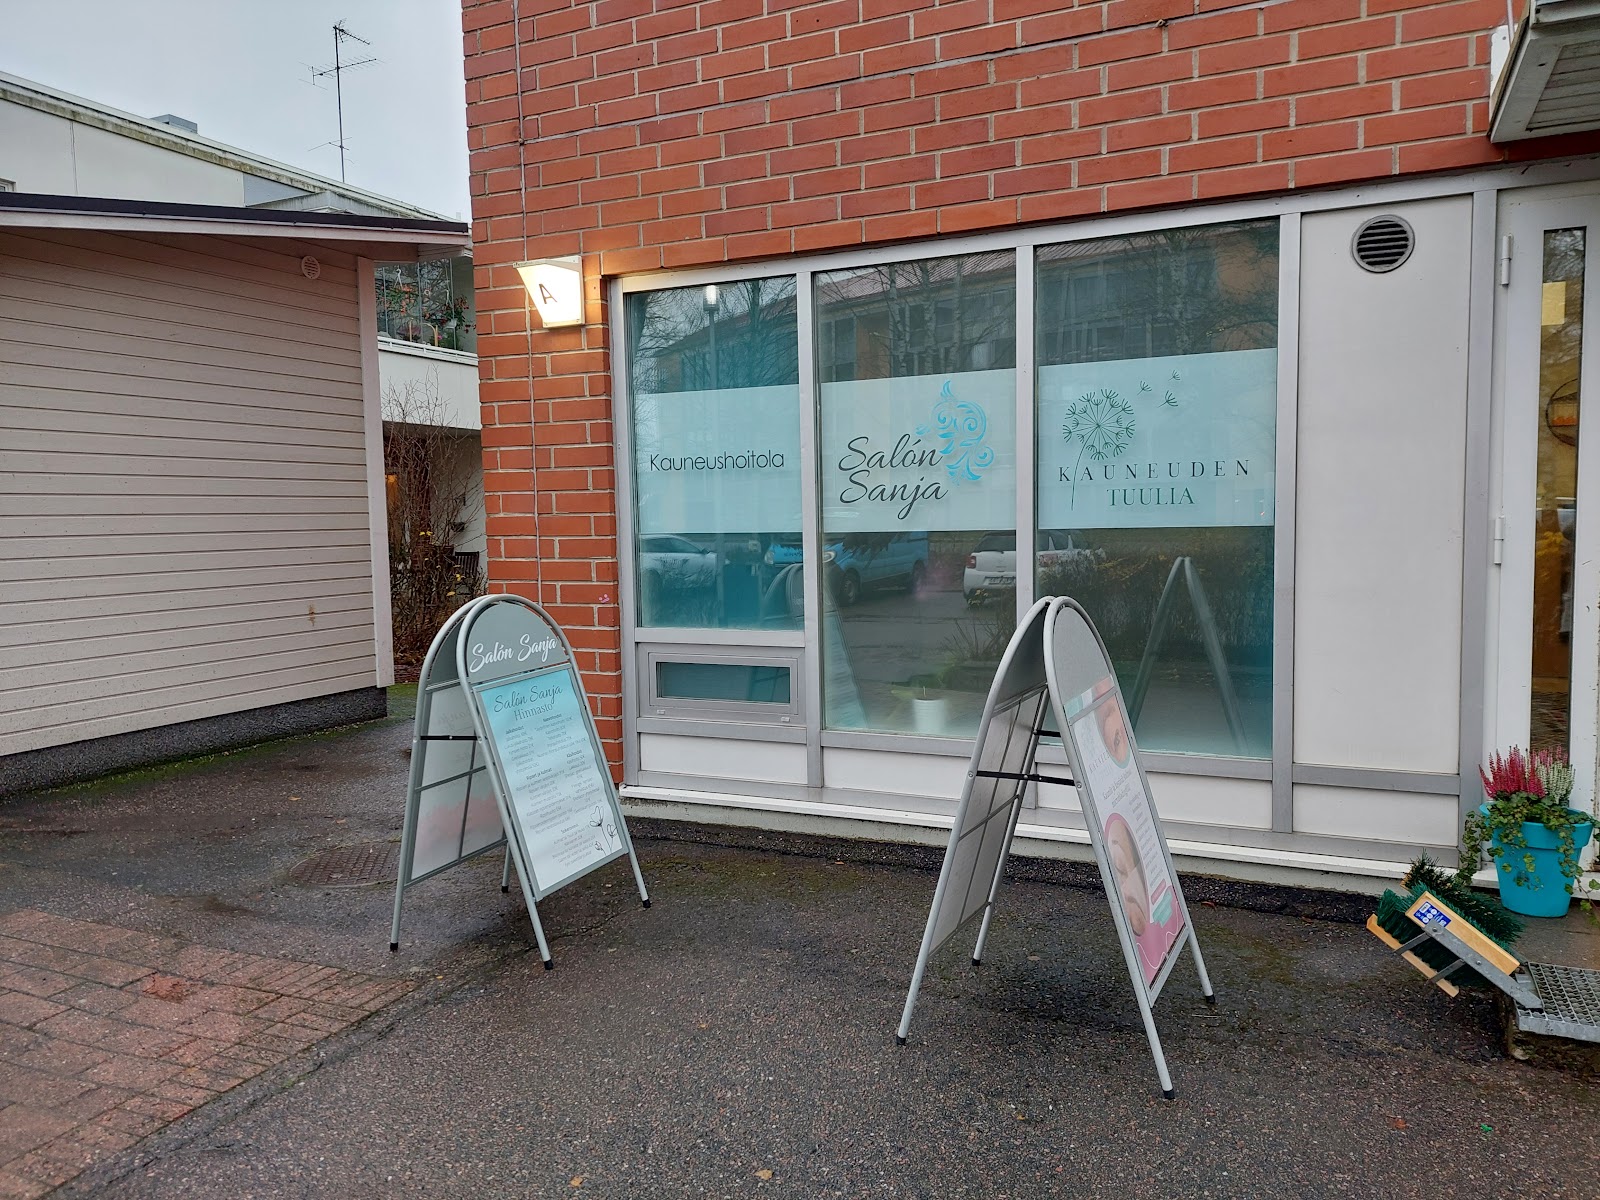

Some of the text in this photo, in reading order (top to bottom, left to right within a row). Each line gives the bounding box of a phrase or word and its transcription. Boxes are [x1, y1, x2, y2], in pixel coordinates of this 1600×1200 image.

[539, 283, 558, 305] A
[650, 449, 785, 471] Kauneushoitola
[838, 433, 944, 471] Salón
[1058, 459, 1250, 482] KAUNEUDEN
[839, 469, 949, 520] Sanja
[1106, 486, 1196, 507] TUULIA
[469, 633, 558, 673] Salón Sanja
[493, 684, 563, 713] Salón Sanja
[513, 702, 553, 721] Hinnasto
